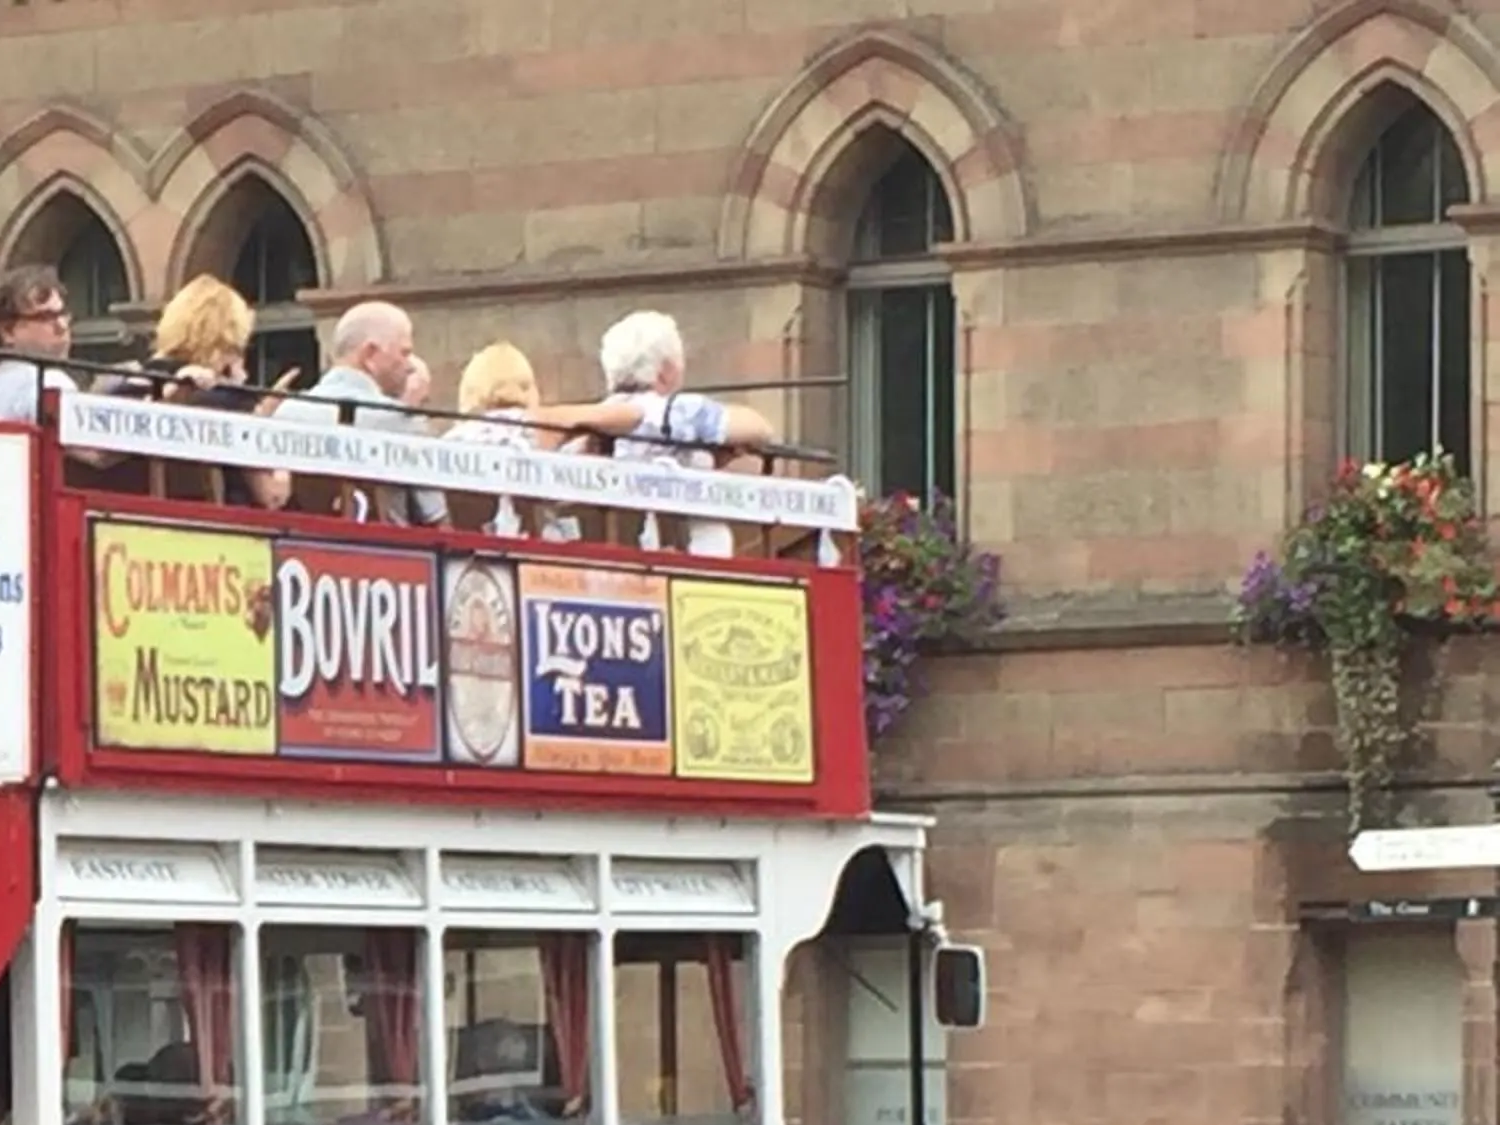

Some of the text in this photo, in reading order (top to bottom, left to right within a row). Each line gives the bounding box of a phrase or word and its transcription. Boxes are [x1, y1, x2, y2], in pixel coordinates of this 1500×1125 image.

[73, 404, 152, 440] VISITOR
[155, 414, 233, 449] CENTRE
[255, 428, 367, 463] CATHEDRAL
[383, 441, 434, 471] TOWN
[436, 446, 486, 476] HALL
[504, 457, 544, 485] CITY
[551, 465, 608, 493] WALLS
[277, 557, 439, 698] BOVRIL
[131, 645, 272, 728] MUSTARD
[553, 677, 642, 730] TEA
